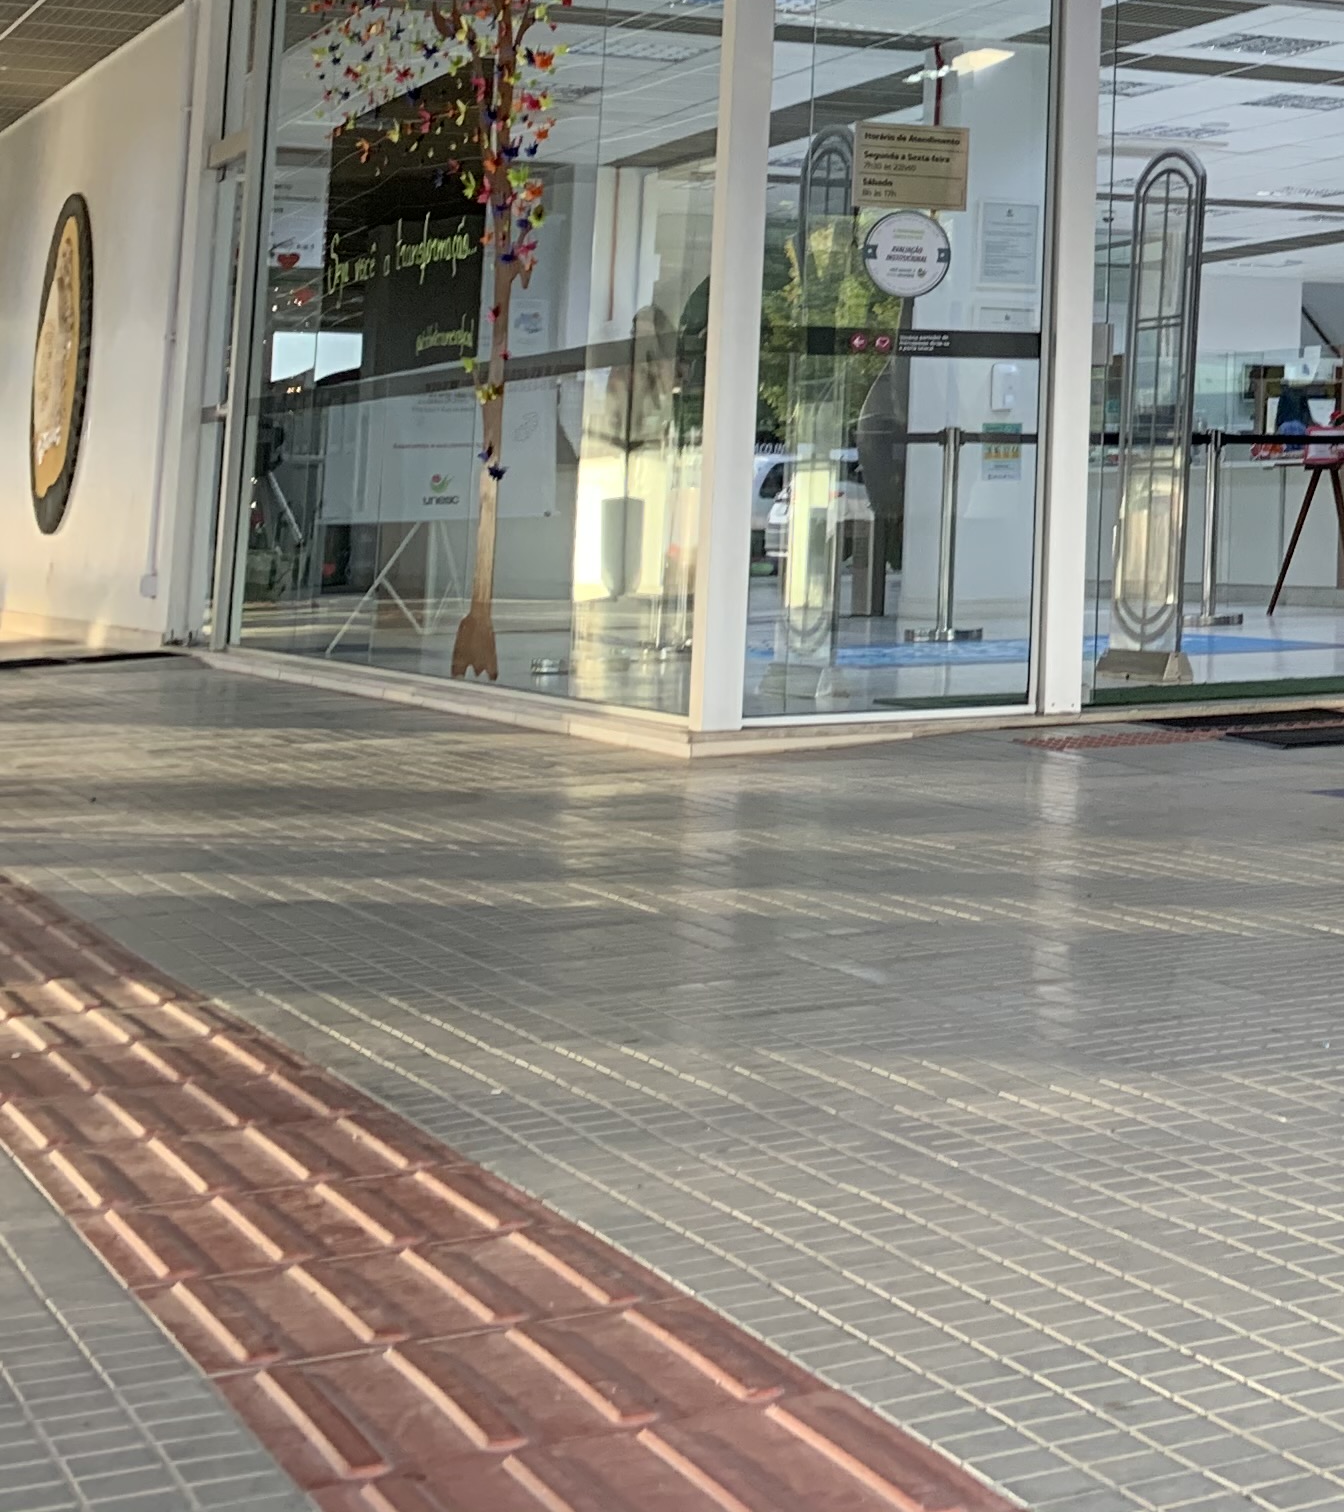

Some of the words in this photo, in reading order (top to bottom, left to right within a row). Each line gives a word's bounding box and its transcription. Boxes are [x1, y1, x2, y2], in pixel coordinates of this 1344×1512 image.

[908, 134, 960, 146] Atendimento
[864, 150, 899, 161] Segunda
[862, 176, 893, 187] Sábado
[422, 494, 460, 506] unesc
